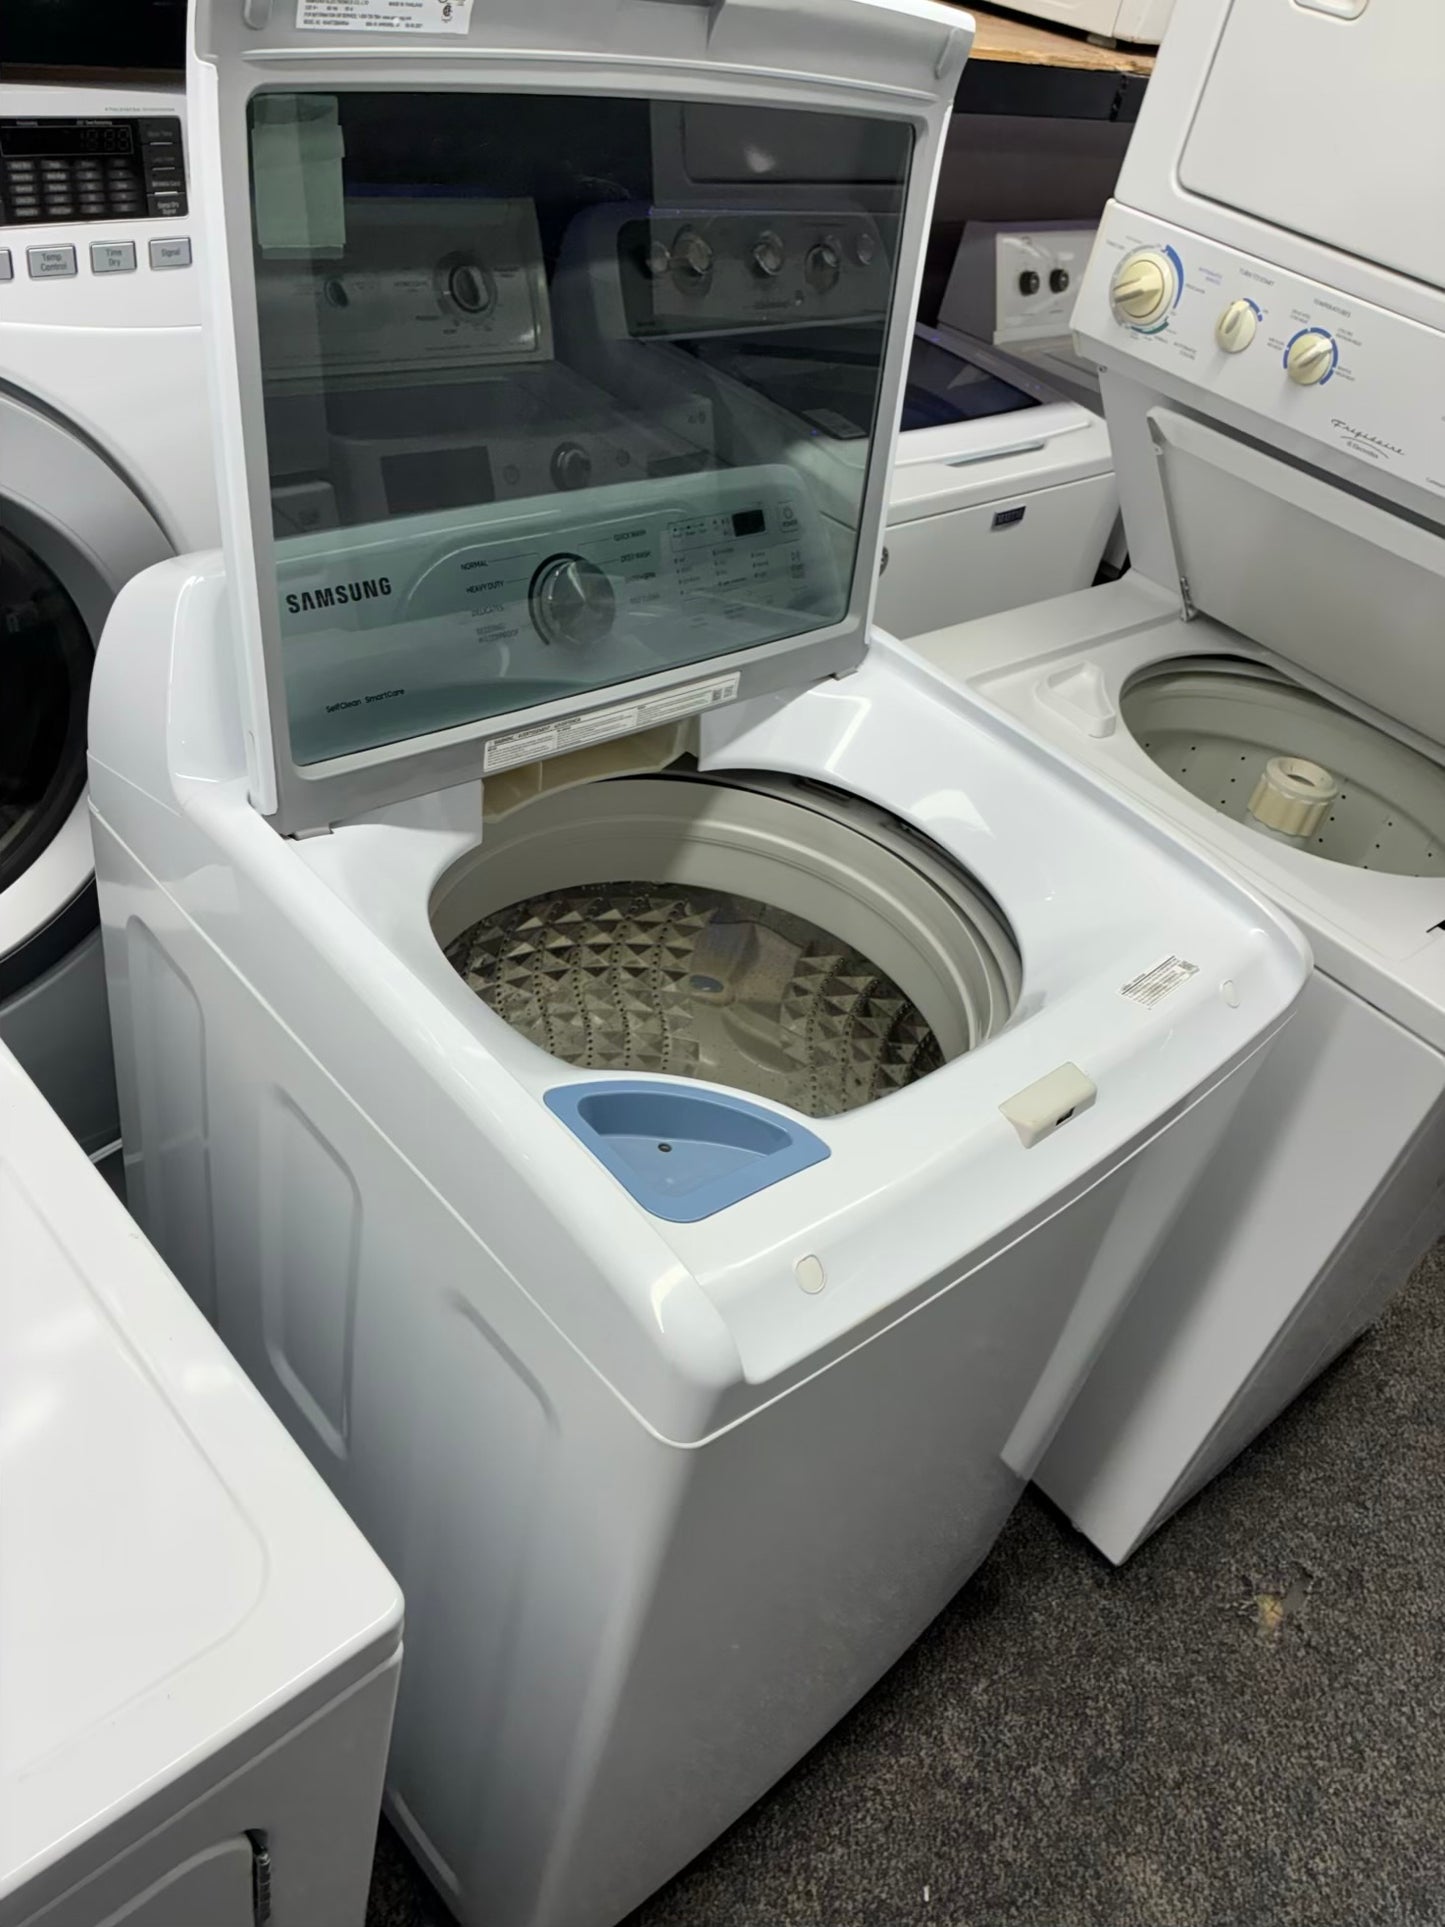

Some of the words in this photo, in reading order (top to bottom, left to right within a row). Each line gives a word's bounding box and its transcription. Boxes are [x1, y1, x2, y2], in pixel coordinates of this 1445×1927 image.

[42, 252, 62, 262] Temp
[106, 248, 122, 257] Time
[161, 248, 181, 258] Signal
[41, 261, 67, 271] Control
[108, 257, 121, 267] Dry
[1330, 418, 1406, 455] Frigidaire
[460, 559, 489, 570] NORMAL
[466, 583, 487, 593] HEAVY
[487, 580, 505, 590] DUTY
[286, 577, 392, 614] SAMSUNG
[325, 698, 362, 713] SelfClean
[364, 687, 405, 704] SmartCare
